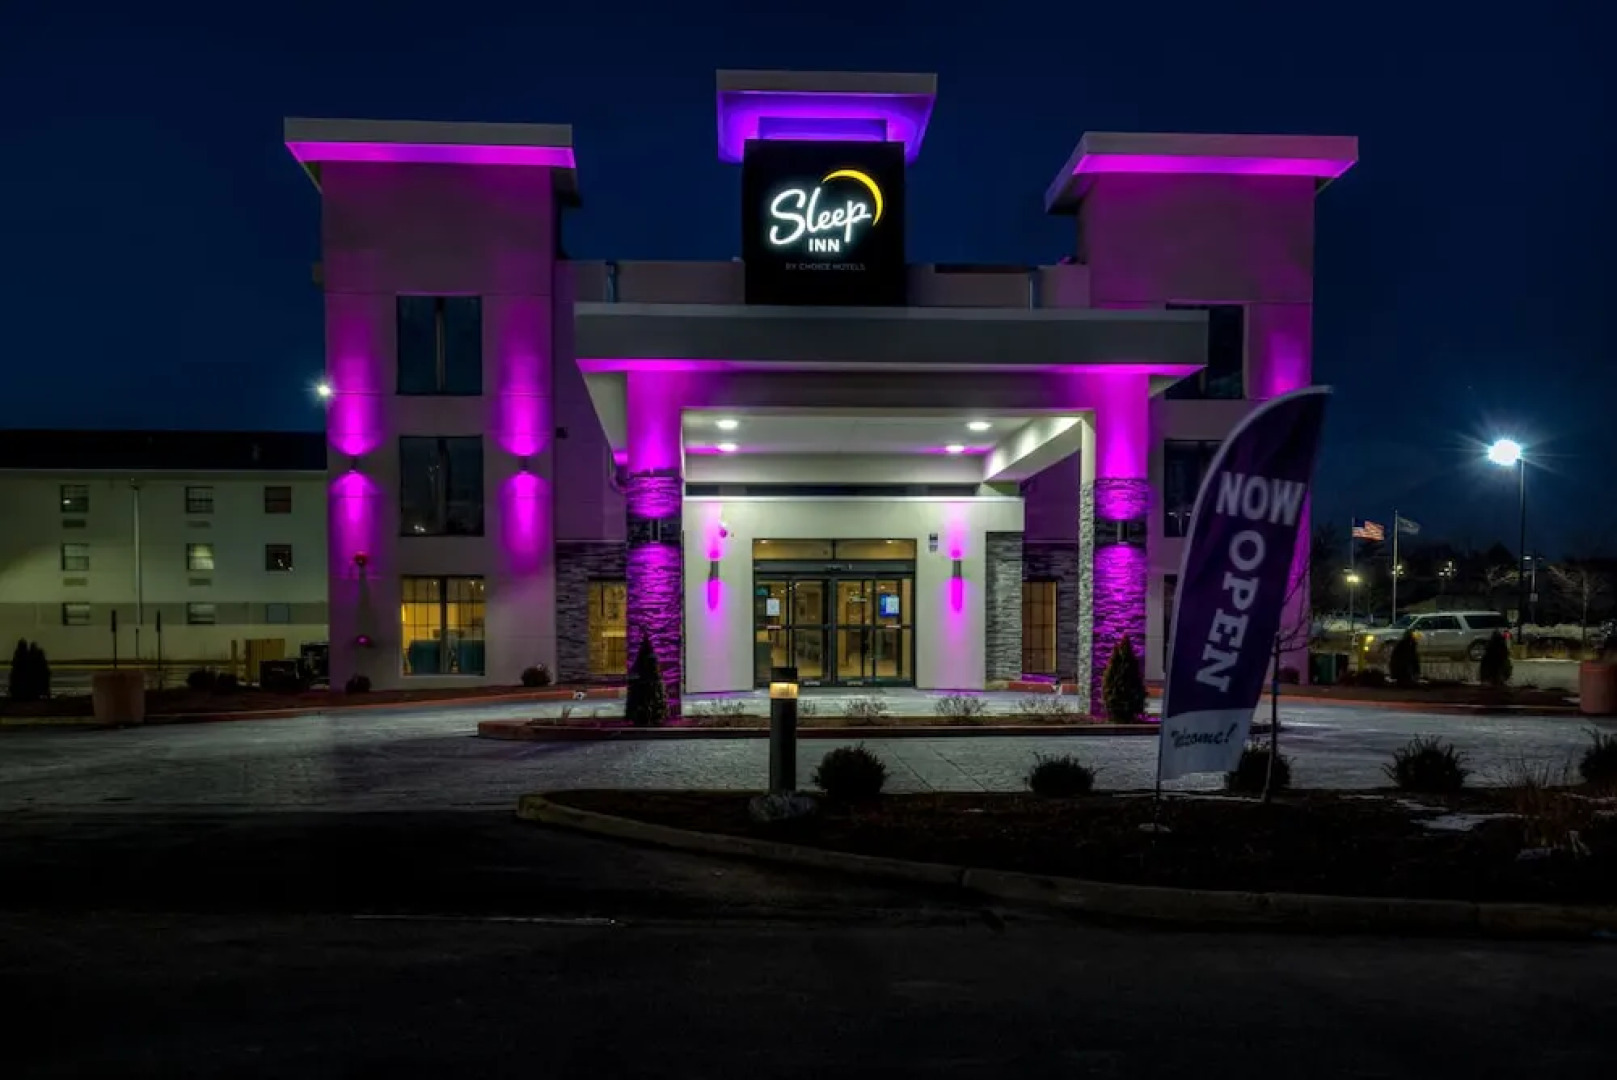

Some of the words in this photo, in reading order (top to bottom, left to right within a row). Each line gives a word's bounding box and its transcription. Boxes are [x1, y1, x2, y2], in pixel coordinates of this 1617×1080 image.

[769, 187, 872, 245] Sleep
[785, 263, 797, 271] BY
[799, 263, 830, 271] CHOICE
[833, 263, 866, 271] HOTELS
[808, 238, 840, 253] INN
[1216, 471, 1305, 526] NOW
[1195, 530, 1266, 693] OPEN
